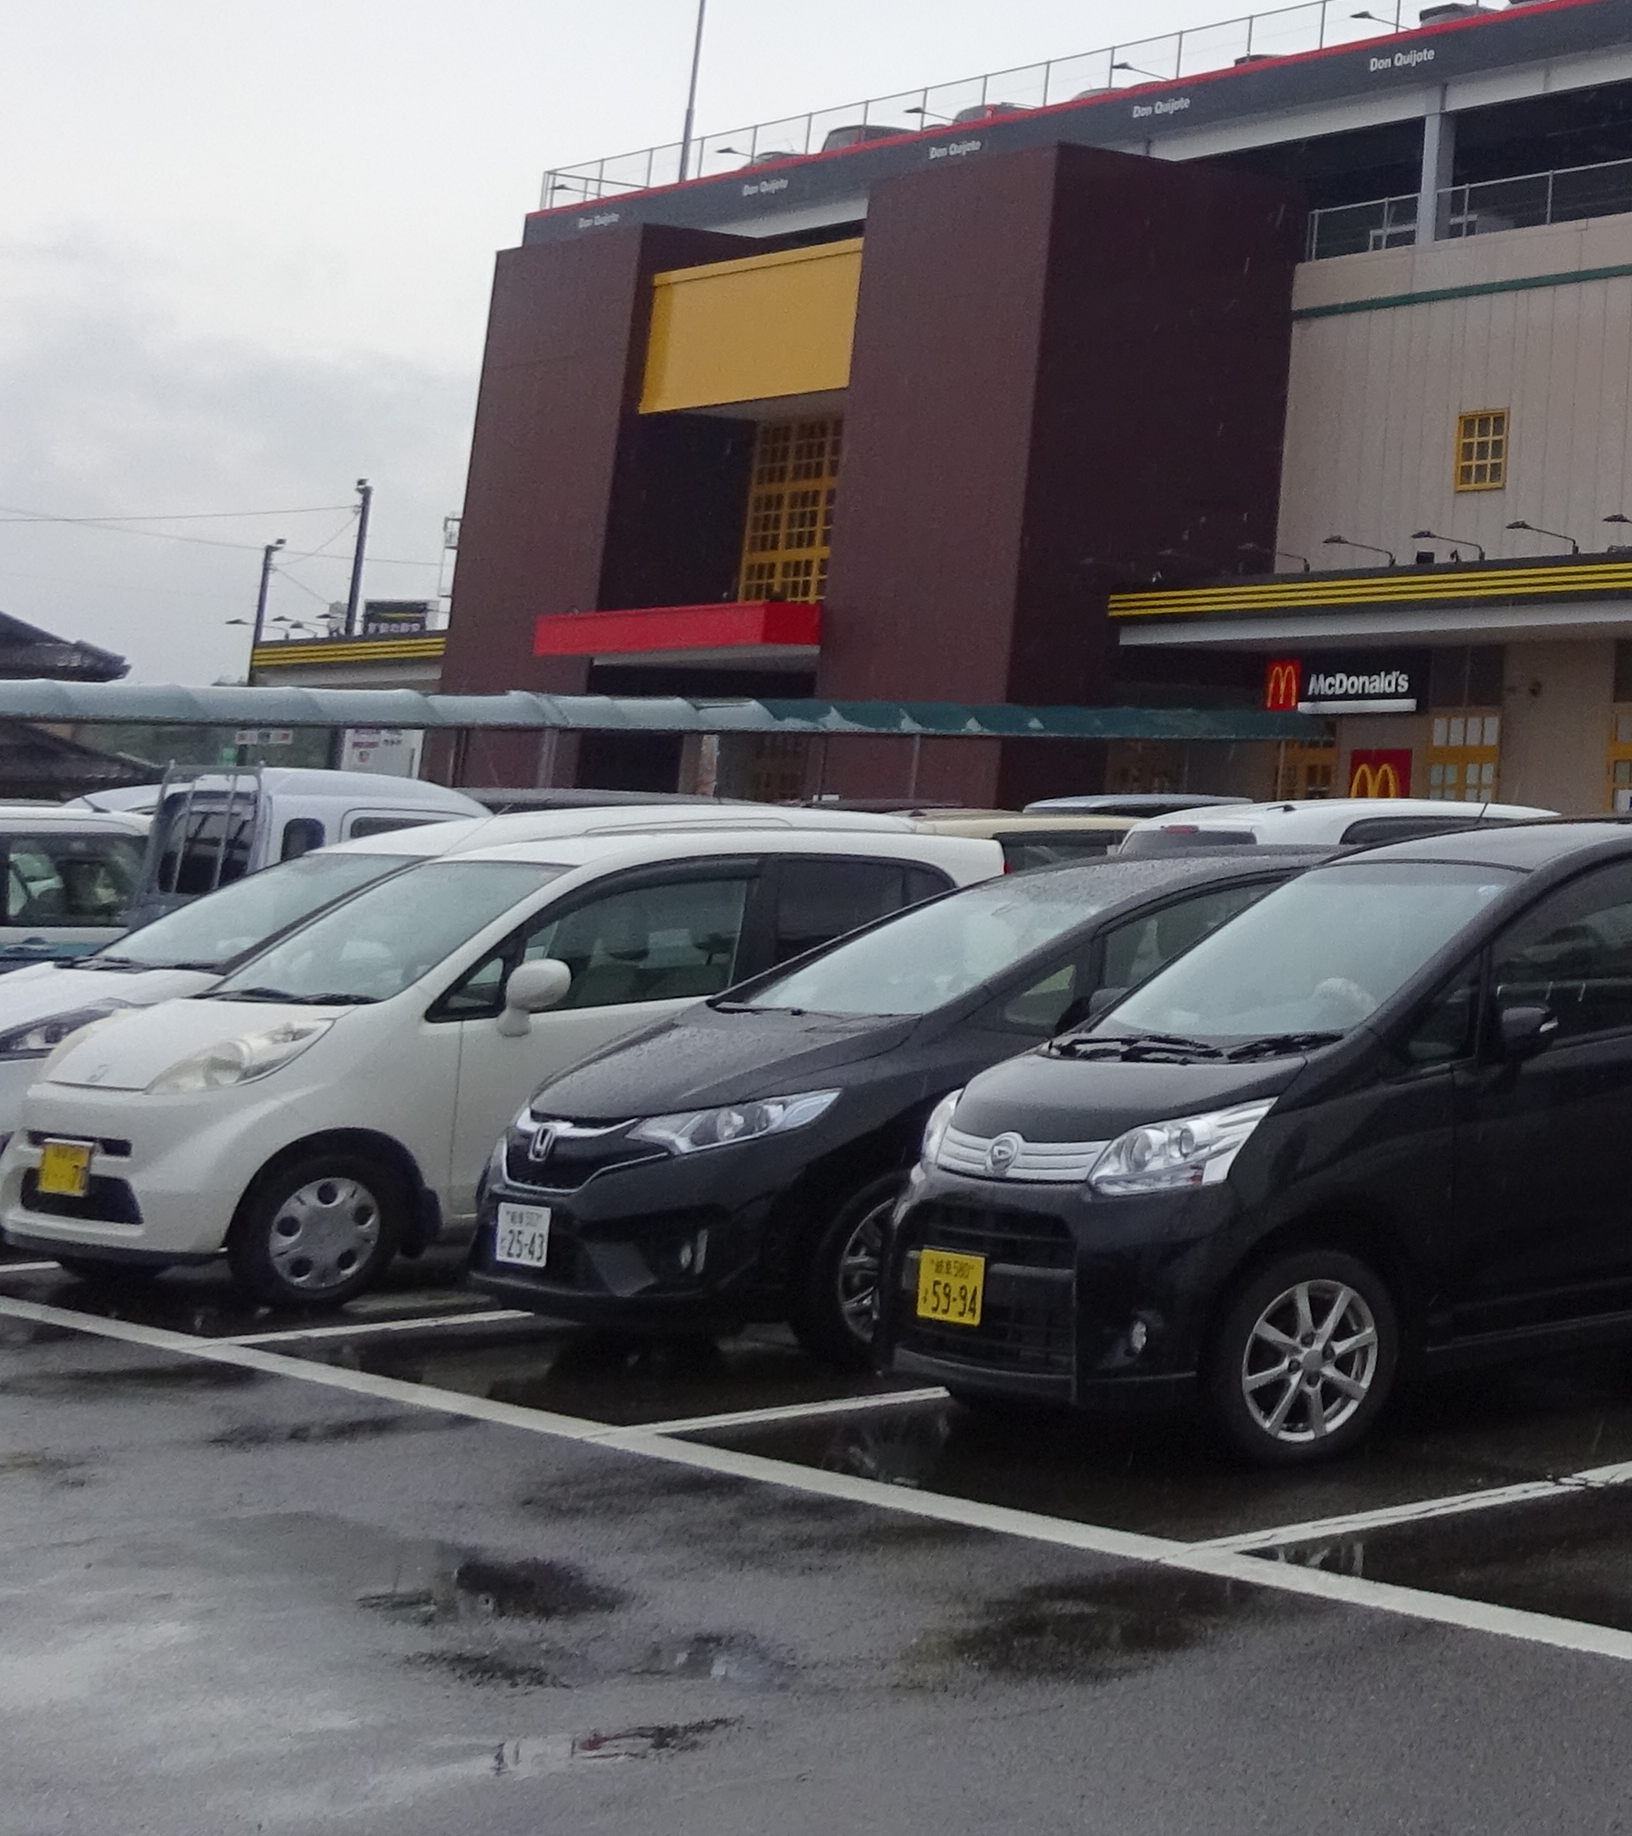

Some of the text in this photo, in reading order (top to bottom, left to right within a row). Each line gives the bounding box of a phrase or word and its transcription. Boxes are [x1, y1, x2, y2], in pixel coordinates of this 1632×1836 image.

[1370, 48, 1435, 72] Don Quijote
[1132, 105, 1152, 118] Don
[1308, 670, 1409, 696] McDonald's
